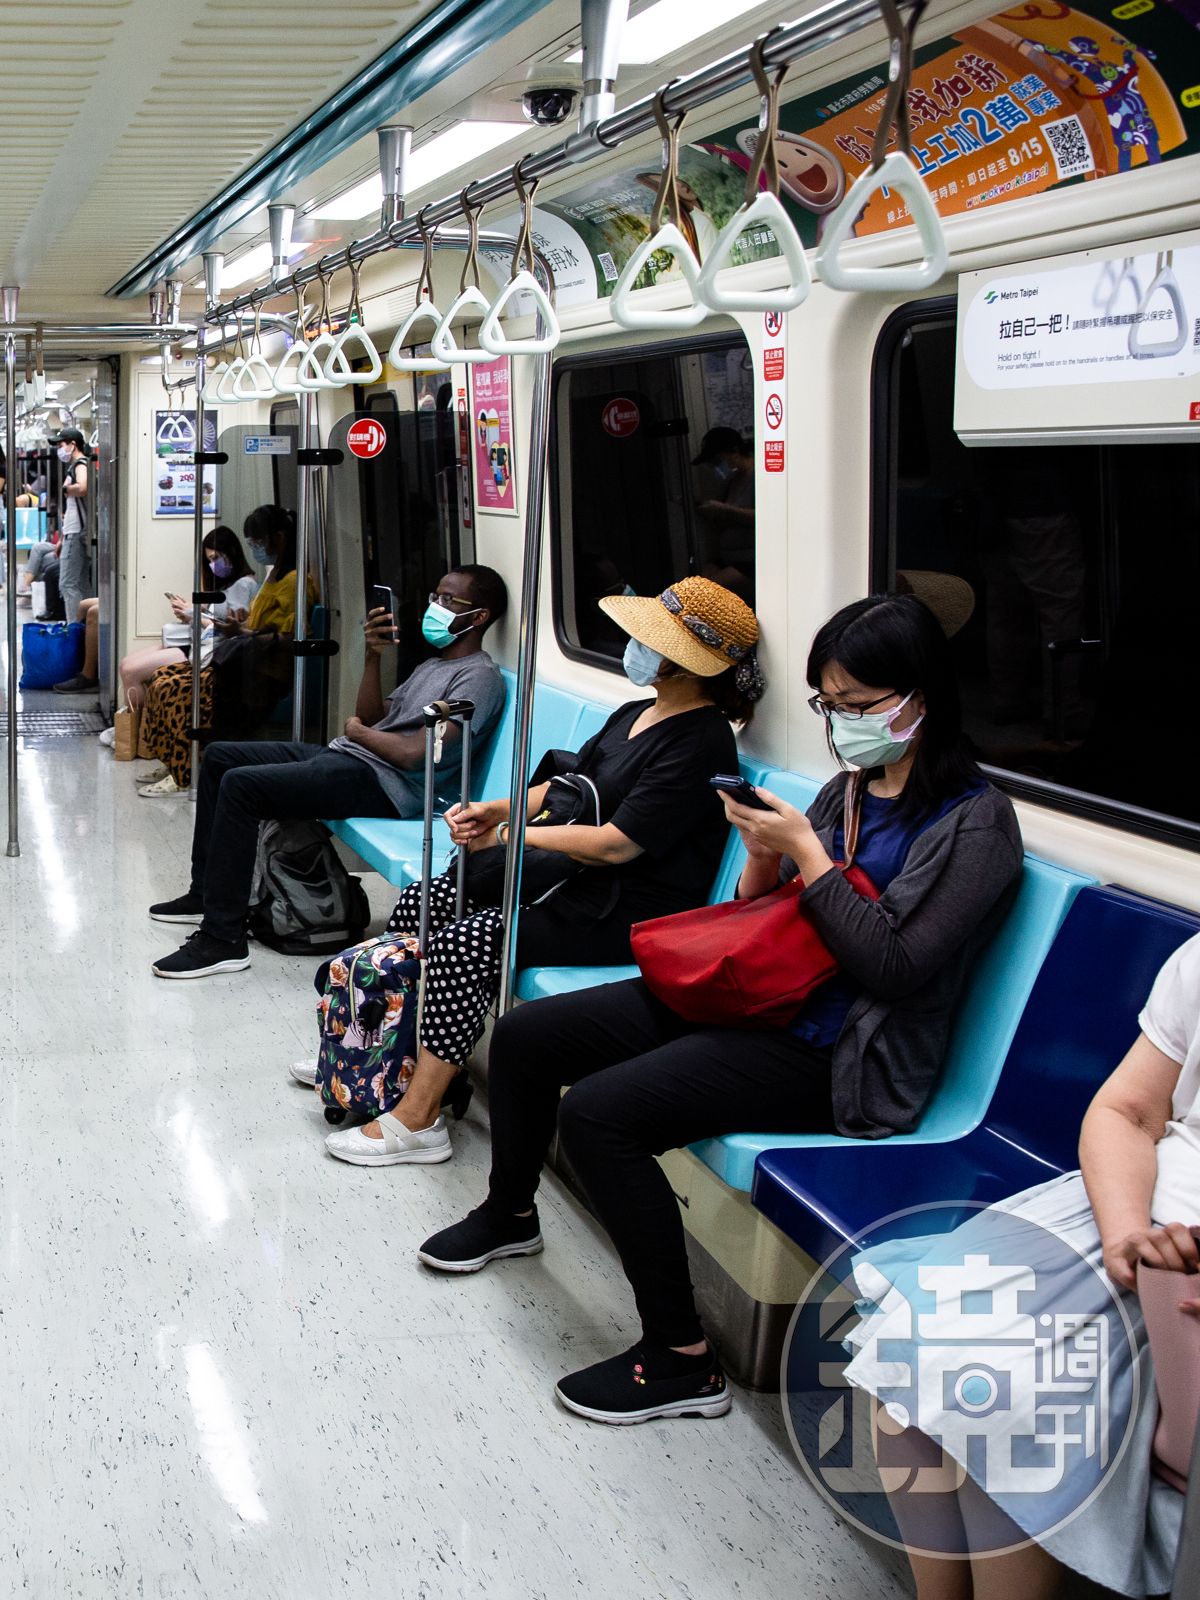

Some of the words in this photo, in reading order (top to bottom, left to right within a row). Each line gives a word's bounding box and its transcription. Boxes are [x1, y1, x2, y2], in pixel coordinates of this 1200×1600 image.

[834, 53, 1008, 164] 你,我加薪
[1008, 137, 1043, 166] 8/15
[966, 162, 1049, 208] www.okwork.taipei
[1001, 291, 1018, 300] Metro
[1020, 287, 1039, 299] Taipei
[1000, 314, 1069, 339] 拉自己一把！
[998, 354, 1012, 362] Hold
[1023, 351, 1036, 361] tight
